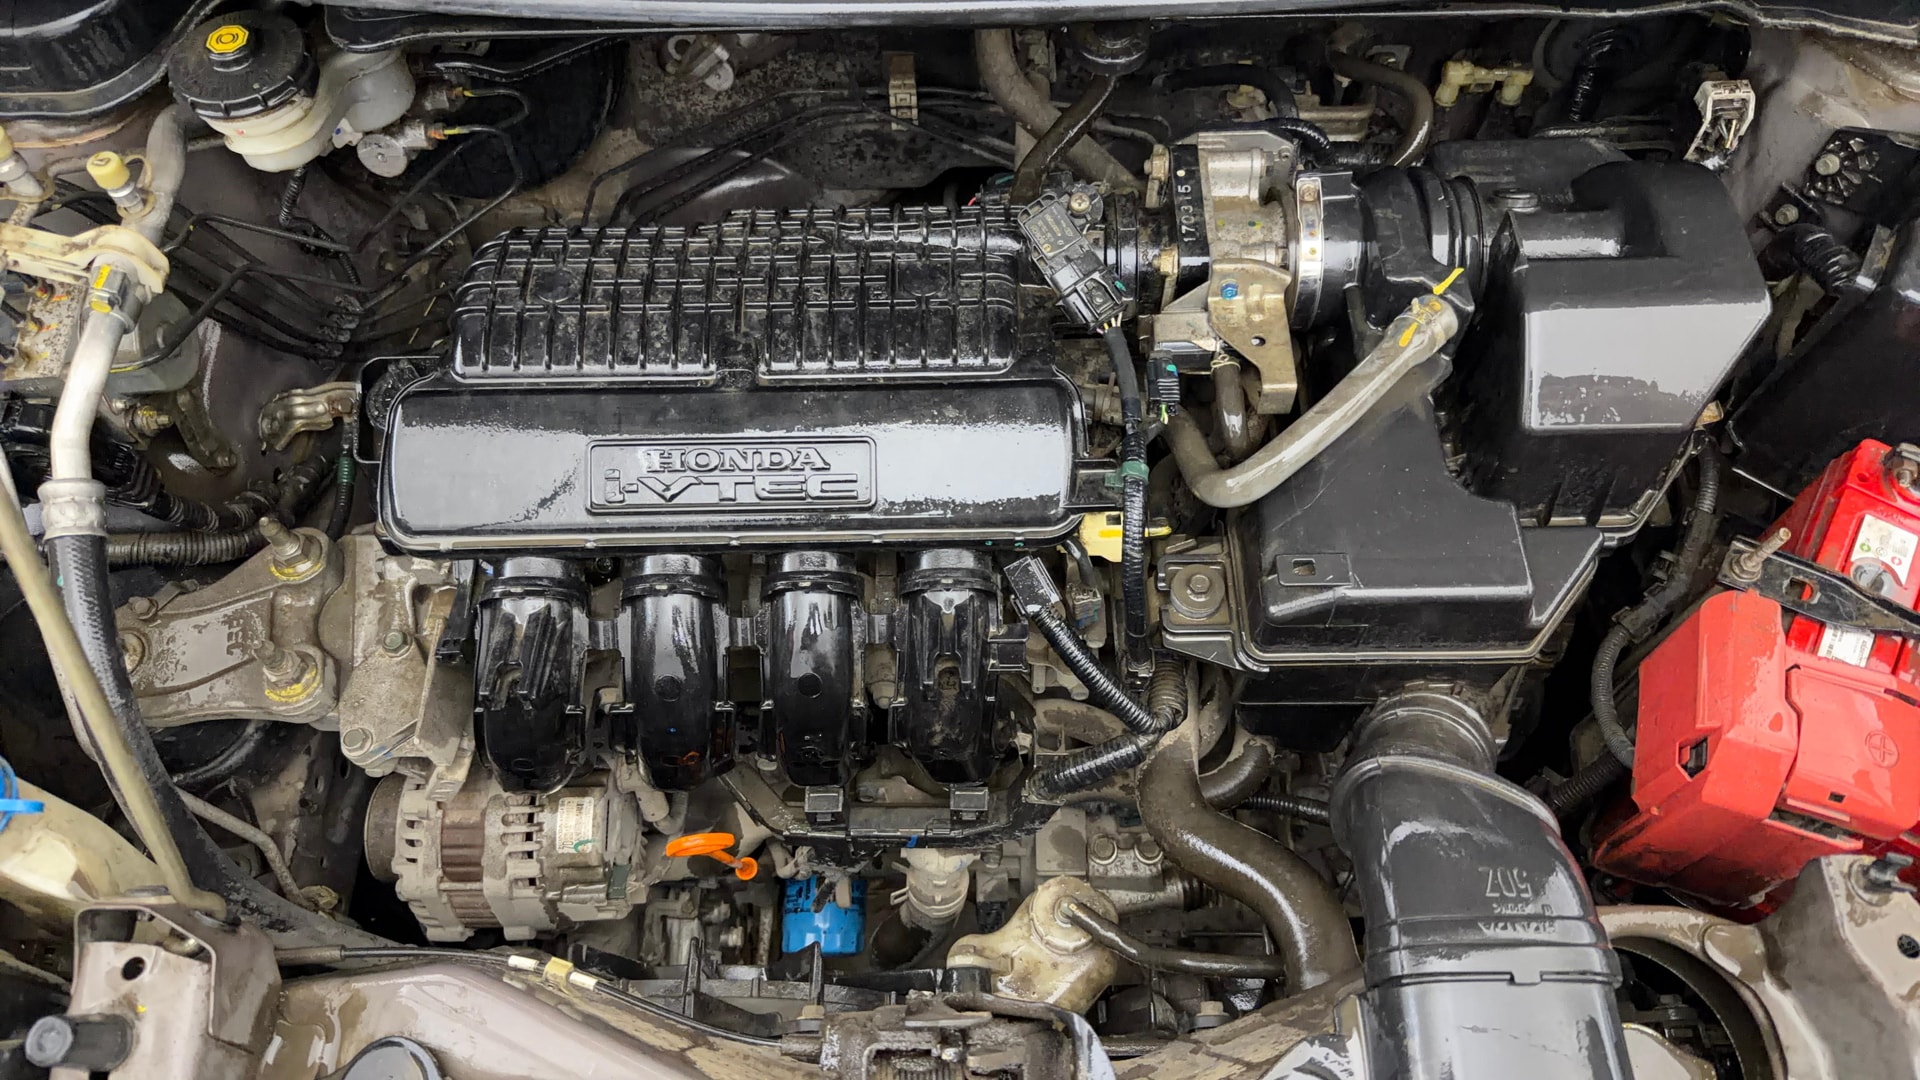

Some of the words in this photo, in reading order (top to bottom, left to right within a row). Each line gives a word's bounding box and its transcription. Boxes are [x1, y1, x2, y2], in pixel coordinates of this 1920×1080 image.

[1177, 184, 1197, 243] 170315
[645, 447, 831, 473] HONDA
[604, 468, 860, 503] i-VTEC
